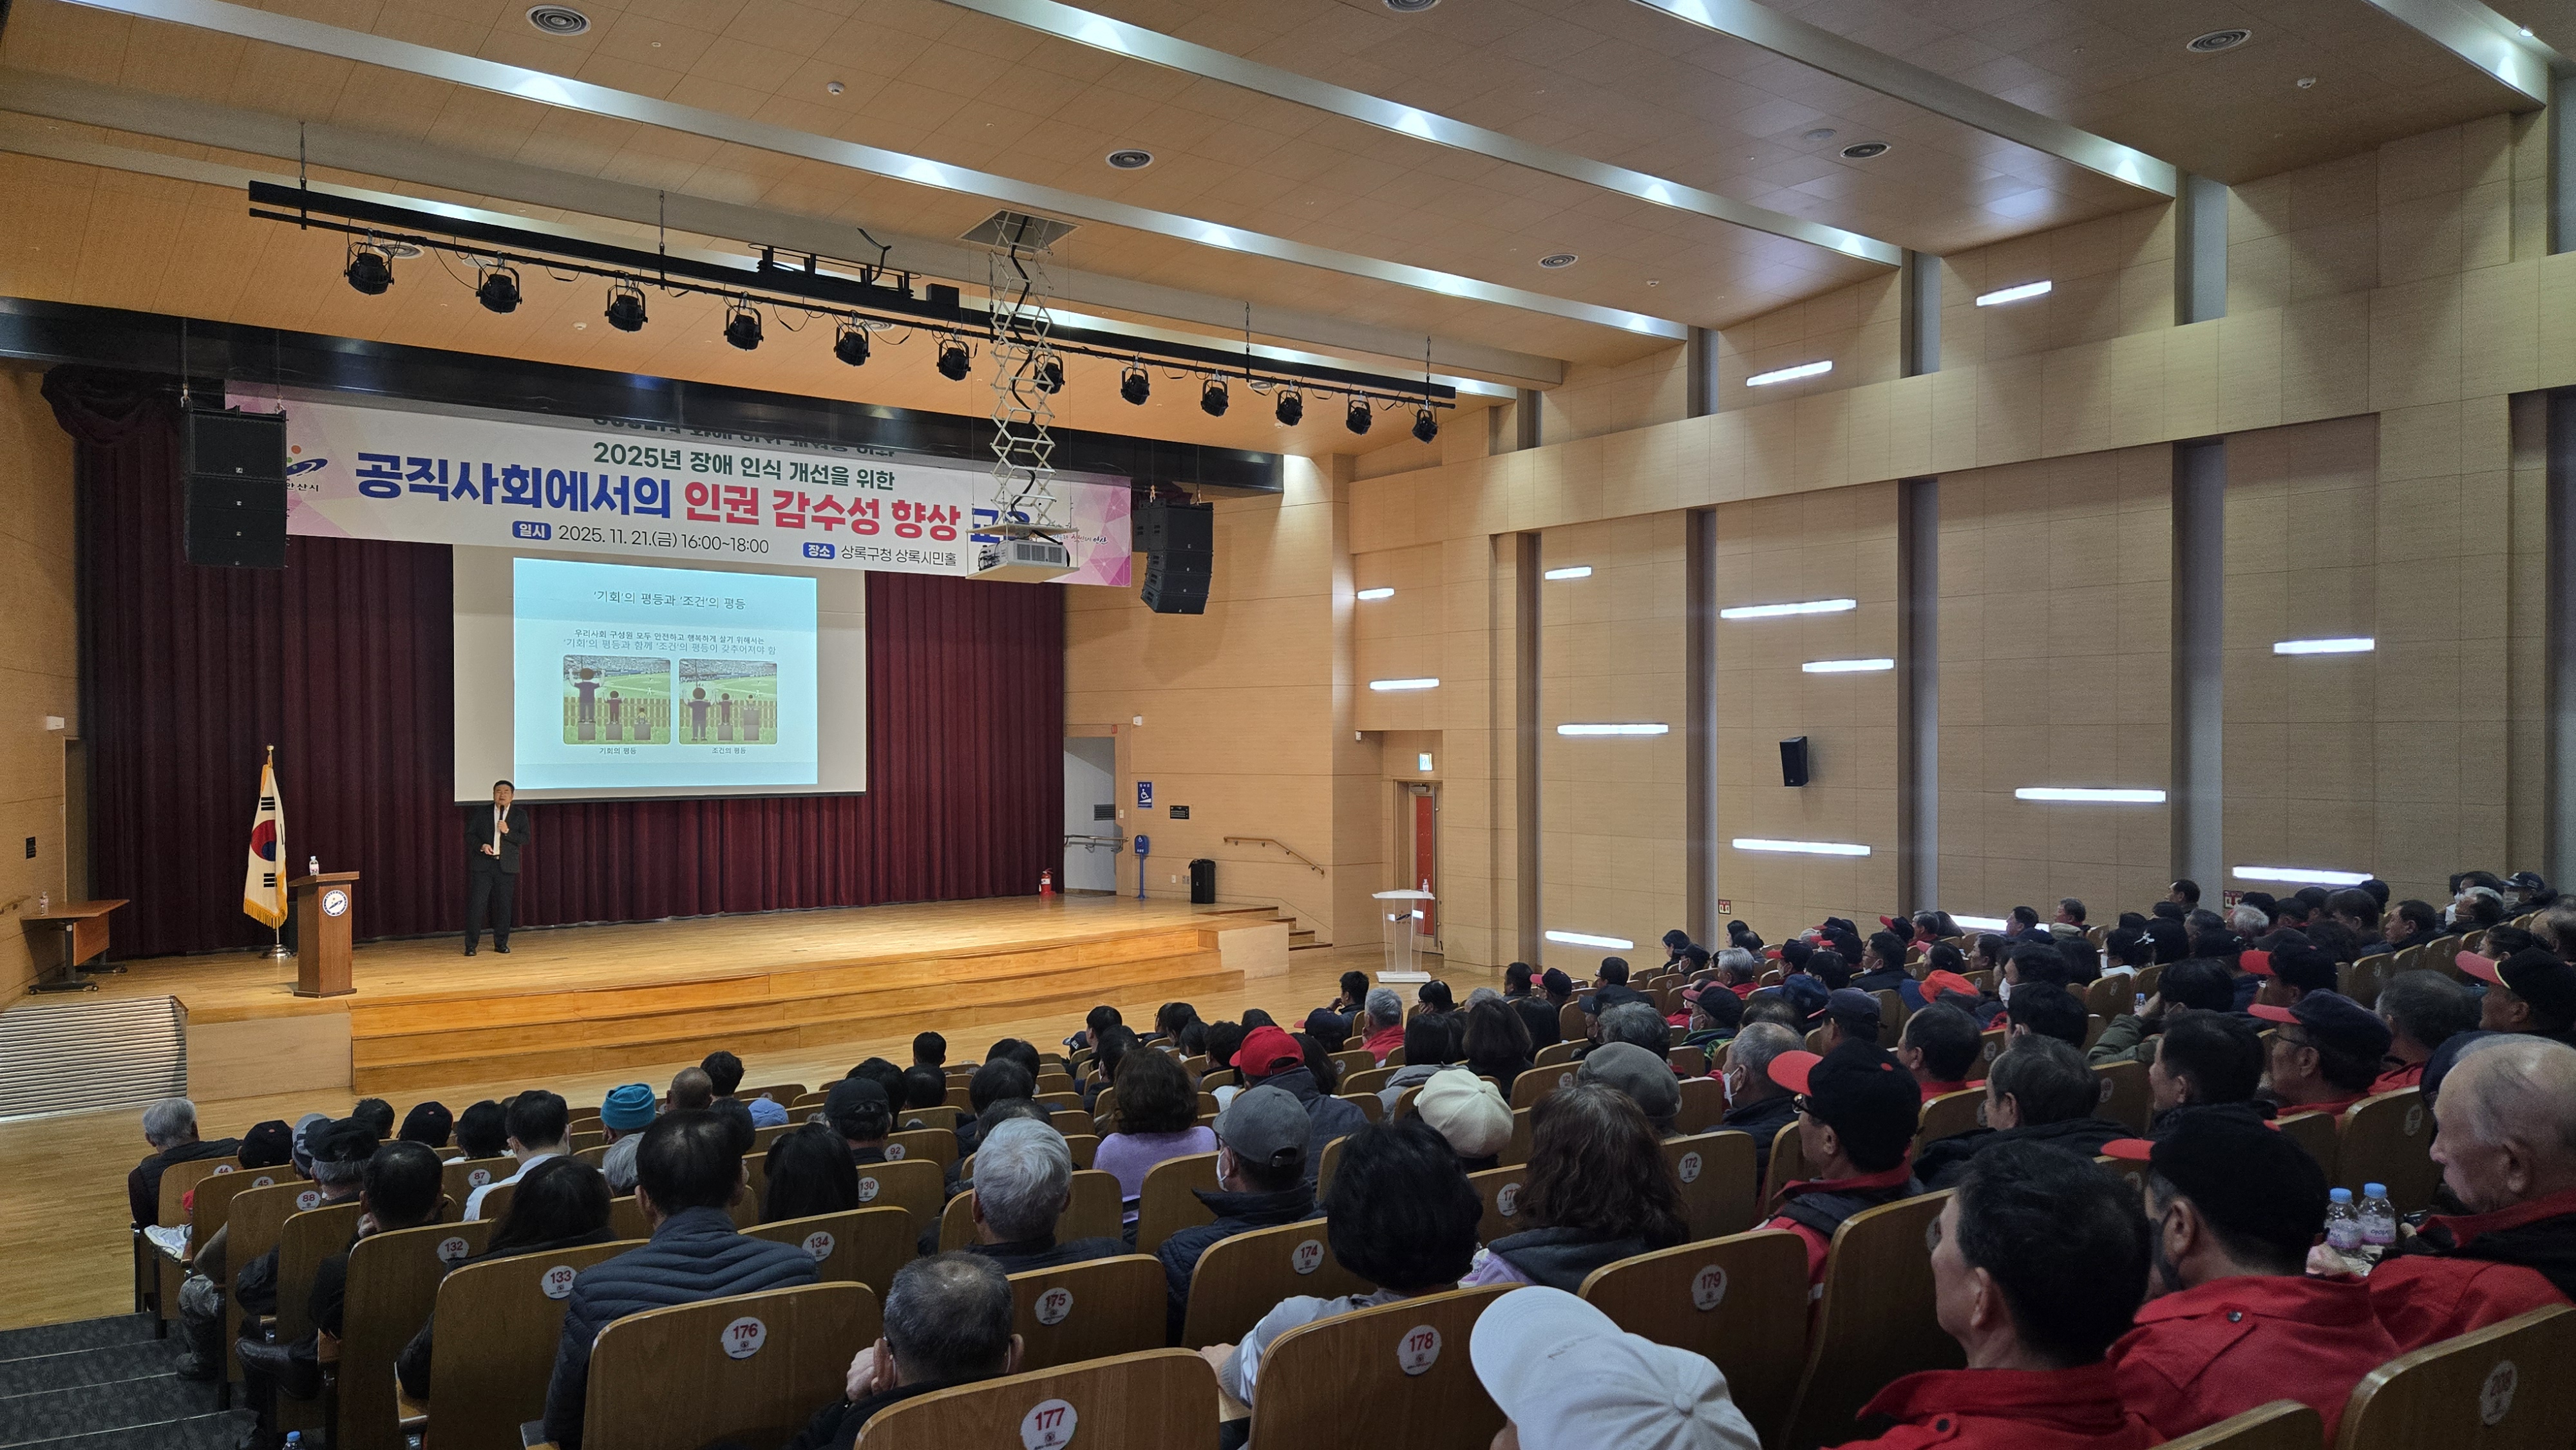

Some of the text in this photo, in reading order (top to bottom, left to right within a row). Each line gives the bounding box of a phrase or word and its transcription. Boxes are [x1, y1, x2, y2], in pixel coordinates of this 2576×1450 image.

[593, 442, 895, 491] 2025년 장애 인식 개선을 위한
[355, 452, 670, 519] 공직사회에서의
[685, 482, 760, 525] 인권
[772, 489, 880, 535] 감수성
[891, 500, 961, 541] 향상
[518, 522, 769, 554] 일시 2025. 11. 21.(금) 16:00~18:00
[1093, 536, 1108, 545] 안산
[808, 544, 957, 567] 장소 상록구청 상록시민홀
[641, 592, 676, 607] 평등과
[724, 598, 746, 610] 평등
[574, 629, 764, 645] 우리사회 구성원 모두 안전하고 행복하게 살기 위해서는
[602, 639, 630, 650] 평등과
[634, 641, 652, 650] 함께
[692, 643, 717, 653] 평등이
[768, 645, 776, 655] 함
[1684, 1157, 1698, 1169] 172
[860, 1181, 875, 1191] 130
[302, 1194, 316, 1202] 88
[444, 1241, 464, 1252] 132
[810, 1236, 829, 1248] 134
[1300, 1245, 1318, 1259] 174
[550, 1270, 572, 1284] 133
[1701, 1271, 1721, 1290] 179
[1045, 1293, 1066, 1308] 175
[732, 1323, 758, 1339] 176
[1410, 1332, 1434, 1352] 178
[1034, 1407, 1066, 1430] 177
